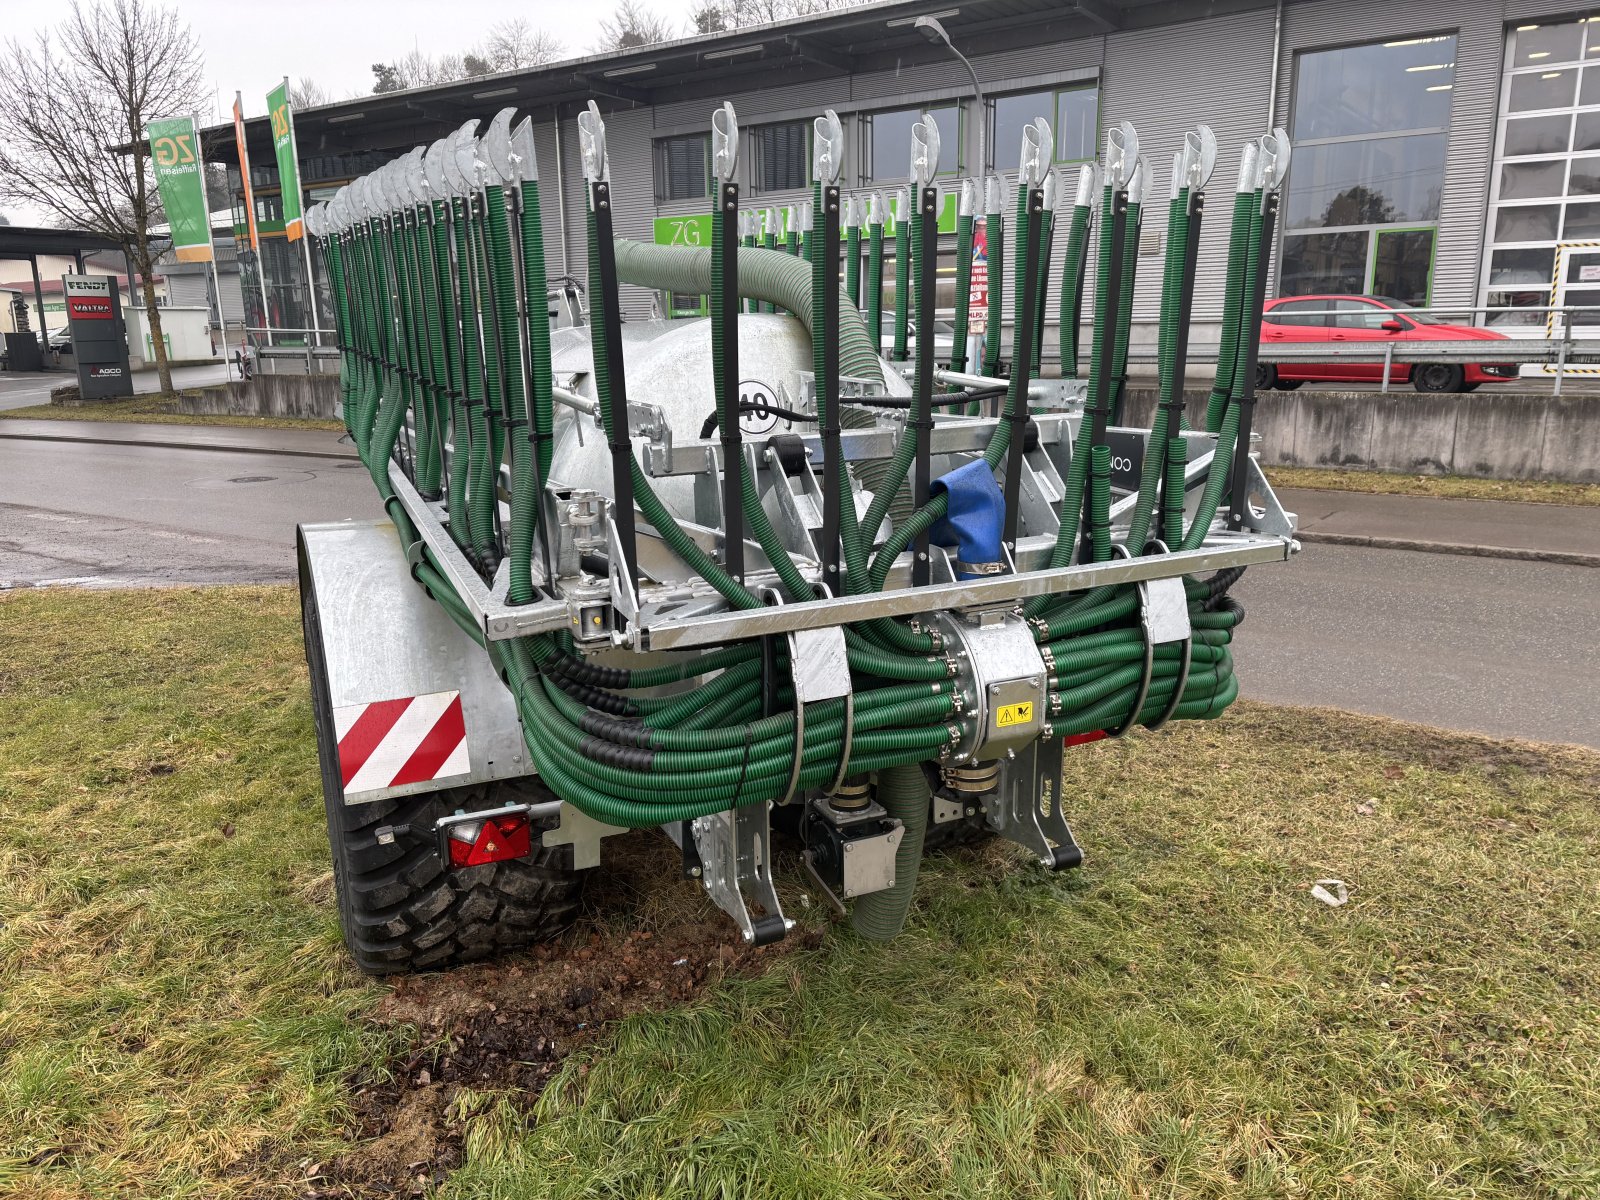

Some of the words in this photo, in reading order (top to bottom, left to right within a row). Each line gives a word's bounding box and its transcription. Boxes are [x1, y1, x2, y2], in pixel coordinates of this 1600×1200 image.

[670, 219, 700, 247] ZG
[68, 281, 107, 290] FENDT
[72, 303, 111, 313] VALTRA
[739, 392, 770, 422] 40
